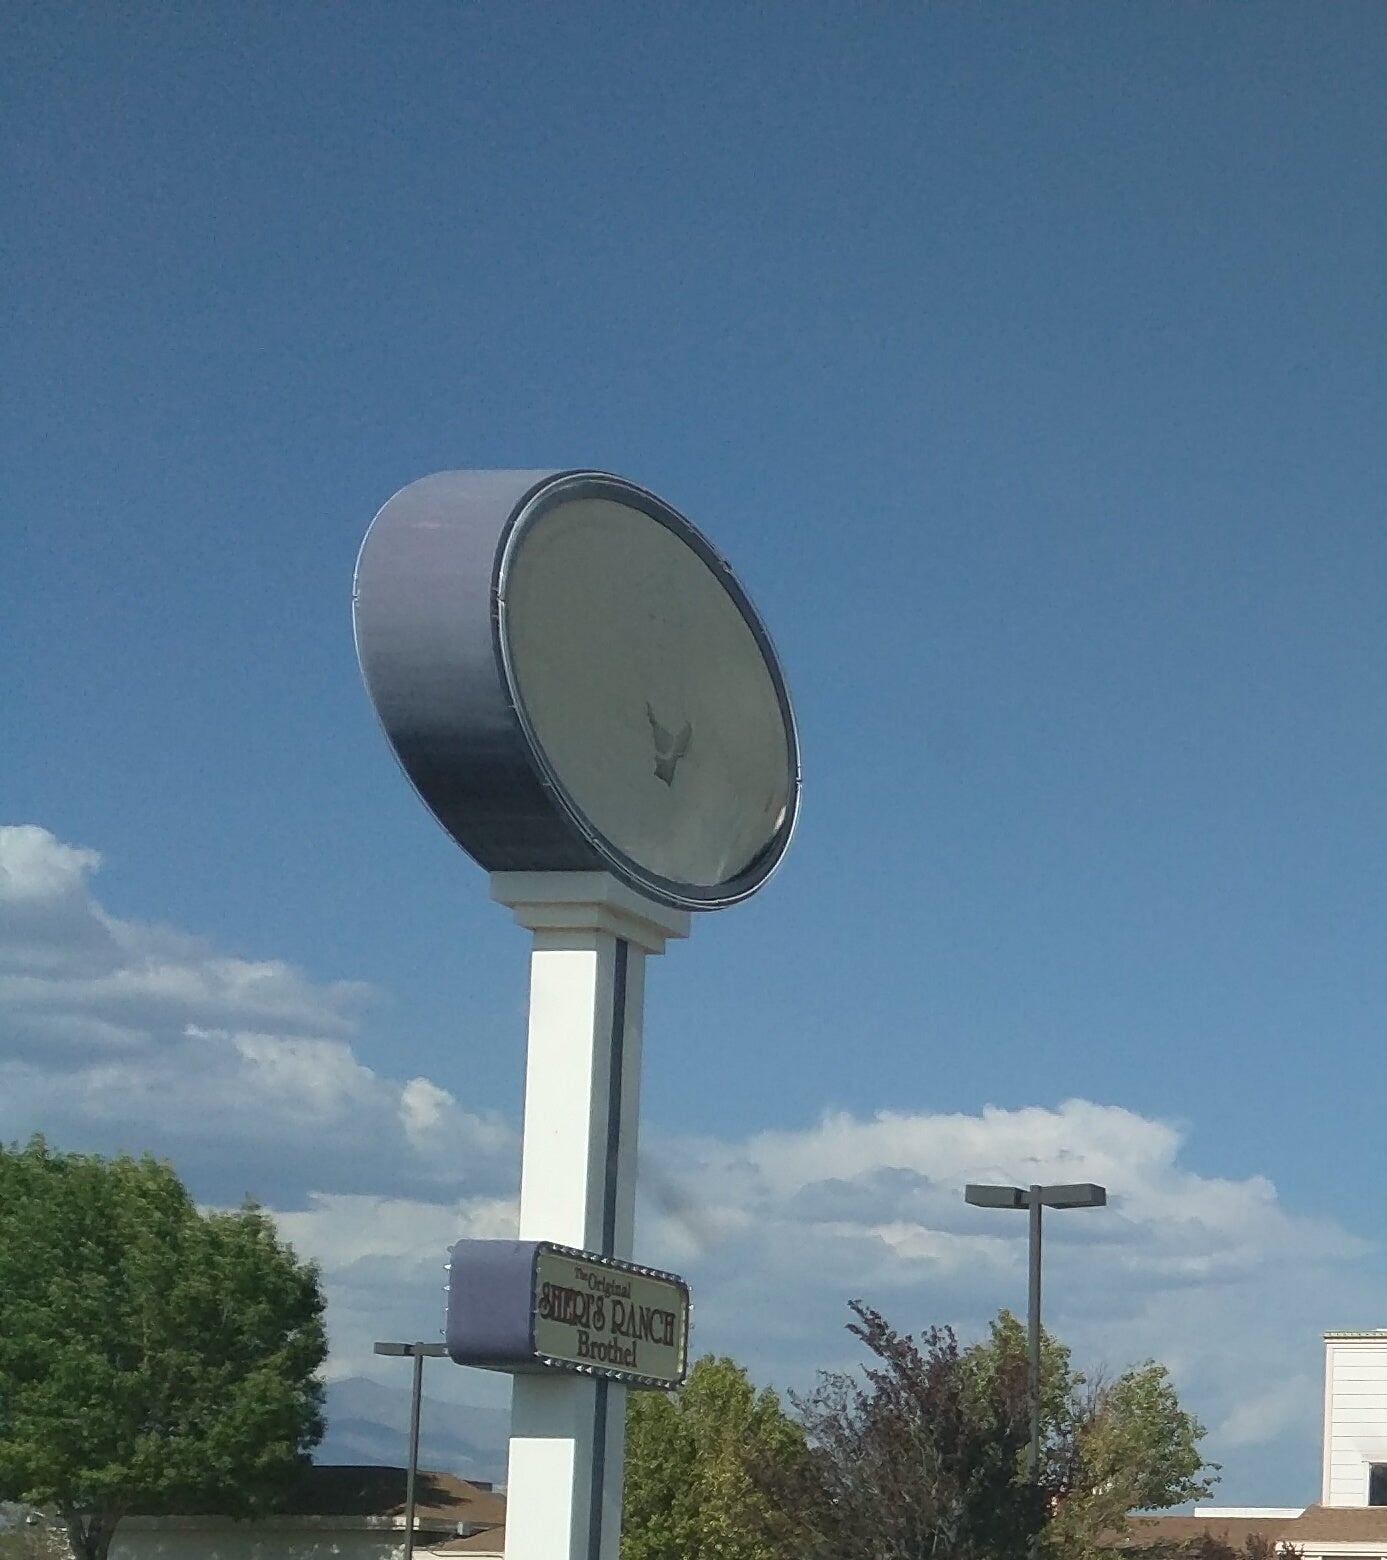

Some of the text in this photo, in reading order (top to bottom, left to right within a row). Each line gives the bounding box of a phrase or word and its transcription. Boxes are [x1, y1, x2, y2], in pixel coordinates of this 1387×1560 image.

[588, 1272, 632, 1299] Original
[539, 1281, 676, 1347] SHERI'S RANCH
[576, 1329, 638, 1368] Brothel
